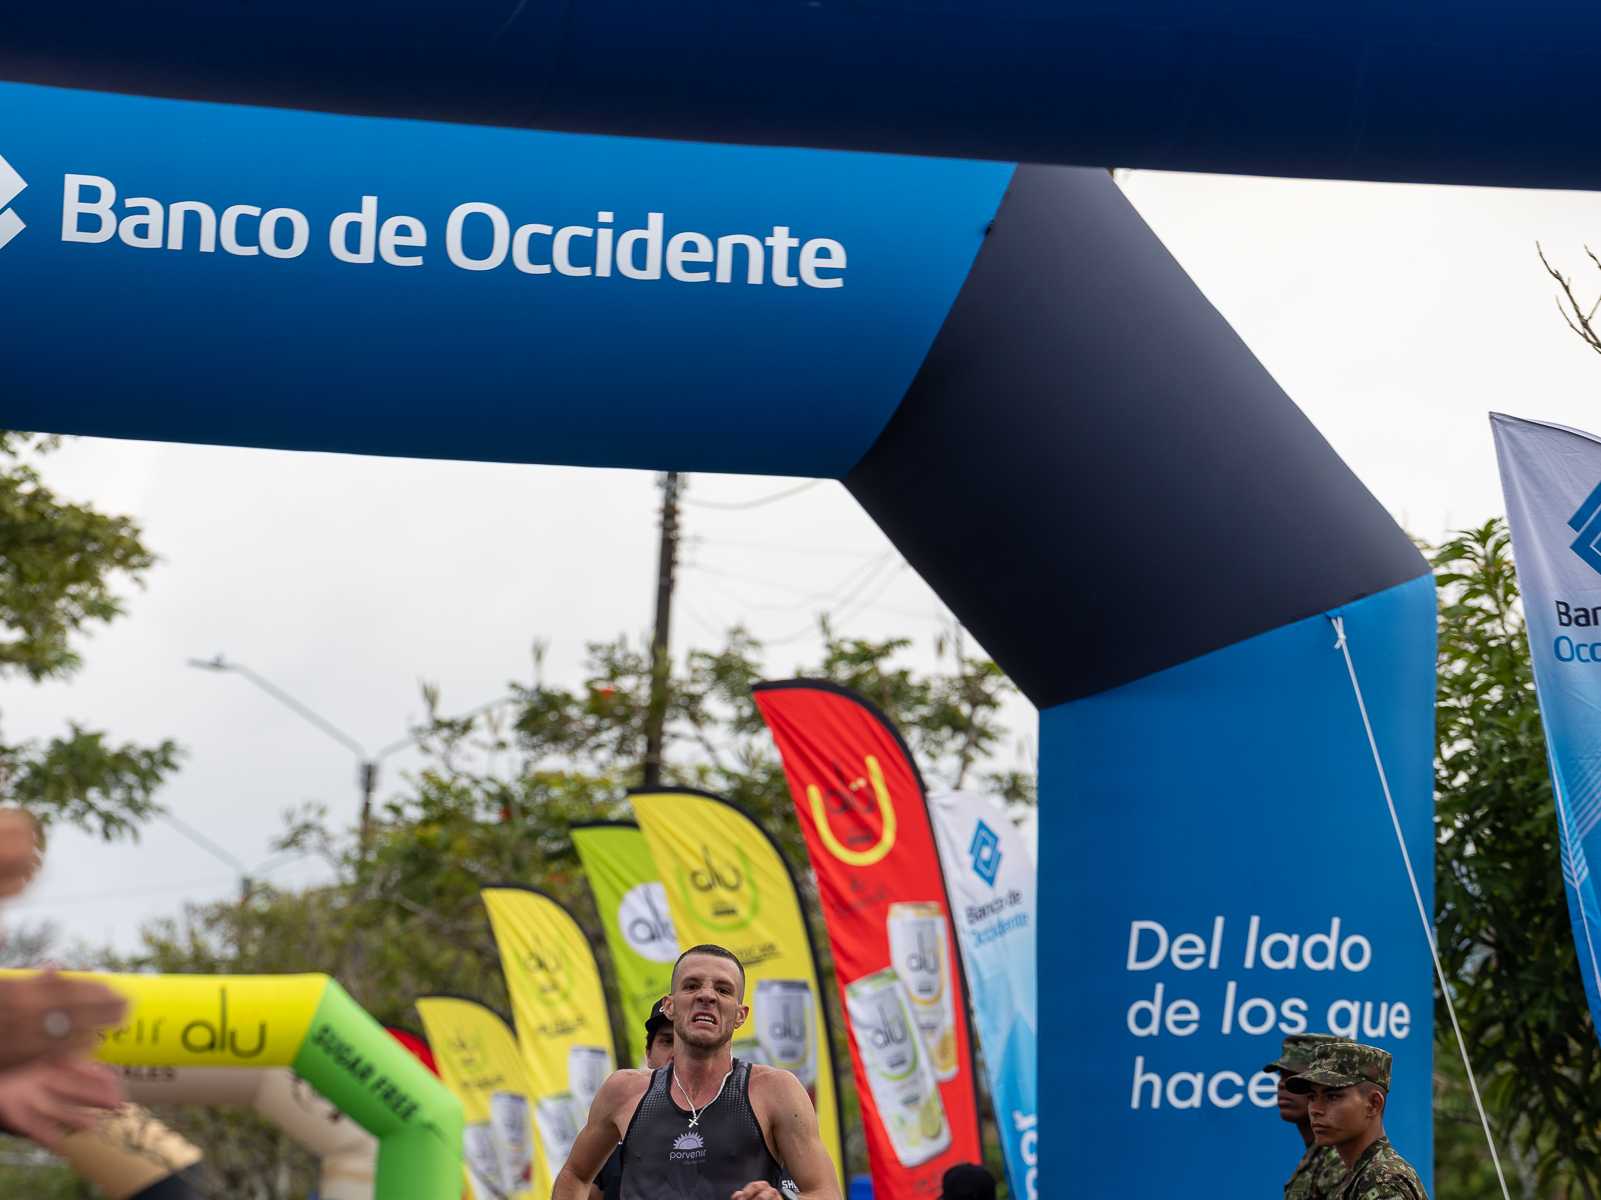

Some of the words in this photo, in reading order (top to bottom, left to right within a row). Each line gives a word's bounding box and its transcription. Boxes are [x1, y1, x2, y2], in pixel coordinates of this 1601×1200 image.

[62, 173, 309, 259] Banco
[329, 195, 427, 267] de
[446, 202, 847, 289] Occidente
[1553, 635, 1601, 663] Occ
[1127, 916, 1224, 971] Del
[1244, 915, 1371, 972] lado
[181, 986, 266, 1059] alu
[1127, 982, 1200, 1037] de
[1221, 981, 1309, 1035] los
[1327, 999, 1411, 1041] que
[1131, 1055, 1279, 1109] hace
[669, 1149, 706, 1160] porvenir
